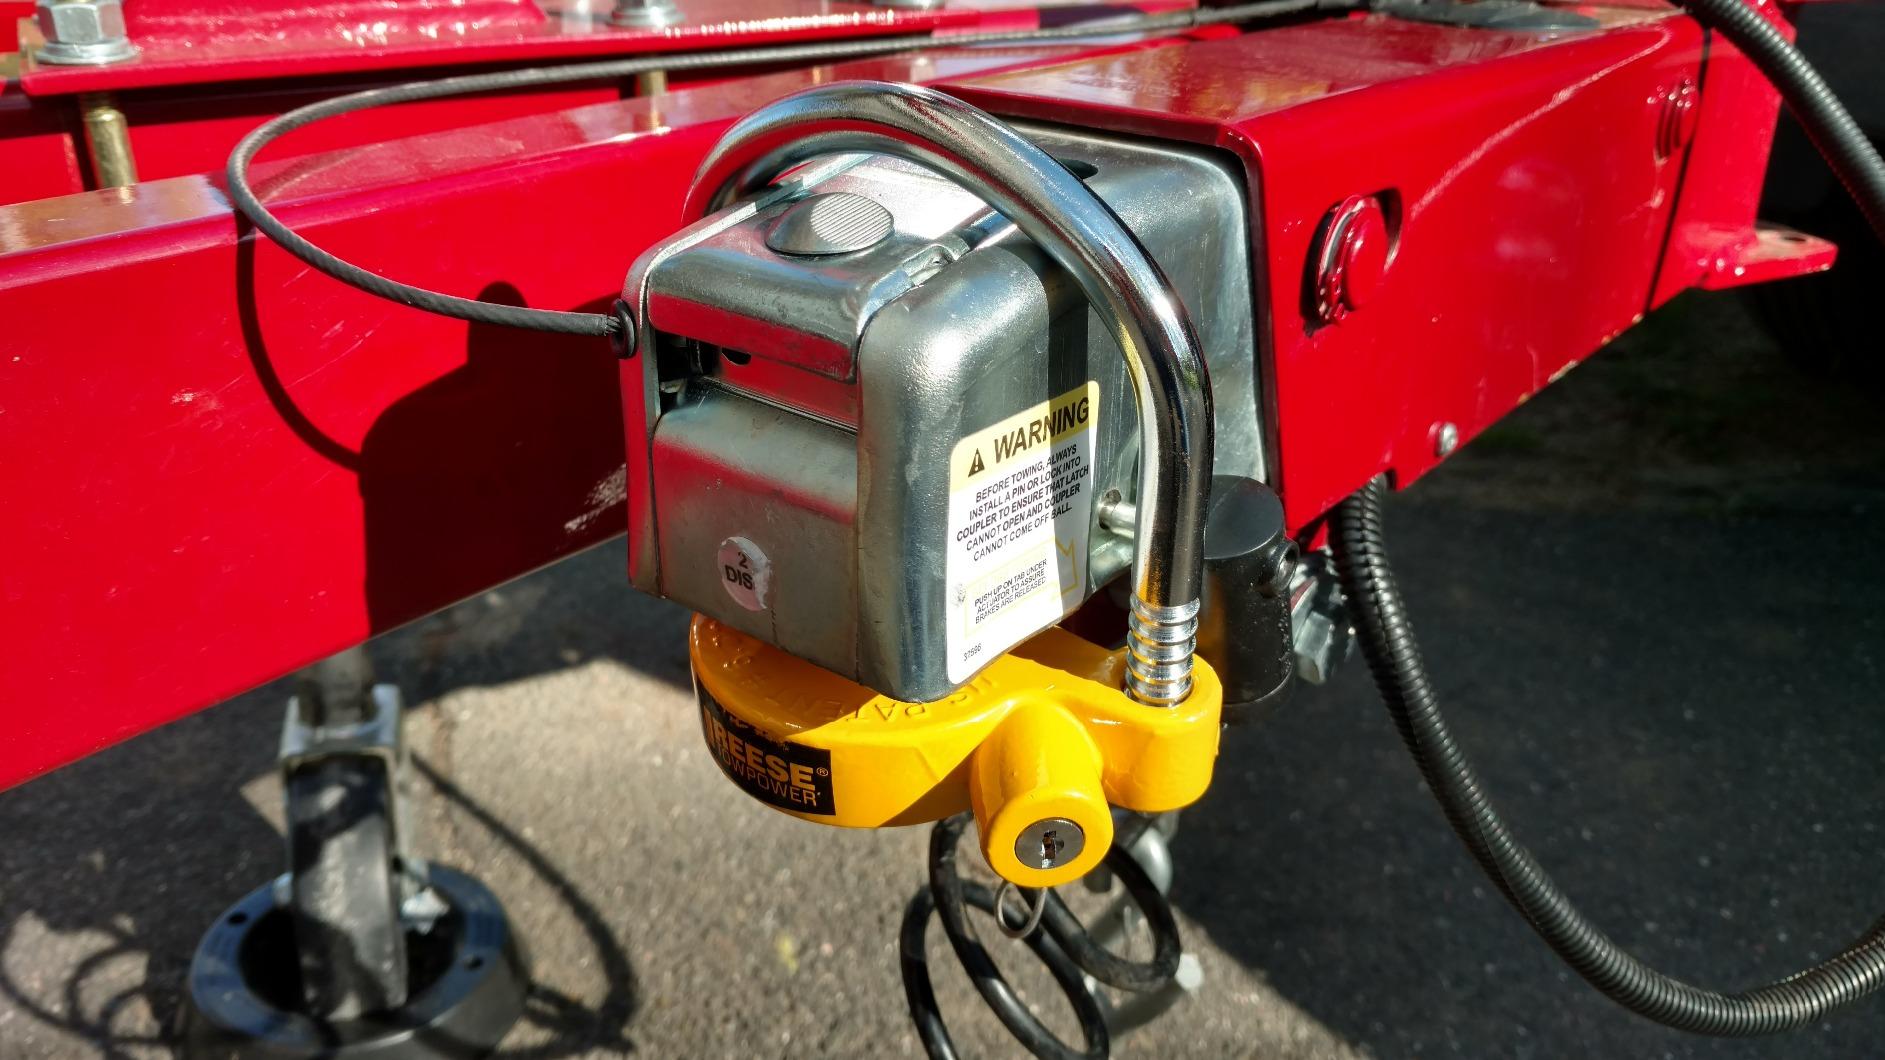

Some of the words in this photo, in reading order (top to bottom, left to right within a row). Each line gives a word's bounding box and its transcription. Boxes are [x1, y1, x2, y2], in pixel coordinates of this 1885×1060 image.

[994, 397, 1089, 464] WARNING
[969, 495, 1005, 521] INSTALL
[1004, 492, 1011, 504] A
[1012, 484, 1025, 499] PIN
[1027, 477, 1039, 491] OR
[1040, 467, 1062, 486] LOCK
[1063, 456, 1081, 473] INTO
[976, 477, 1010, 503] BEFORE
[1011, 461, 1044, 484] TOWING,
[1046, 444, 1077, 467] ALWAYS
[956, 513, 997, 542] COUPLER
[999, 506, 1010, 520] TO
[1011, 488, 1043, 513] ENSURE
[1045, 477, 1065, 496] THAT
[1066, 464, 1089, 486] LATCH
[966, 524, 1001, 551] CANNOT
[1002, 511, 1026, 531] OPEN
[1026, 502, 1043, 520] AND
[1044, 482, 1081, 509] COUPLER
[738, 551, 748, 569] 2
[973, 535, 1008, 561] CANNOT
[1009, 521, 1033, 541] COME
[1034, 513, 1050, 528] OFF
[725, 564, 753, 590] DIS
[974, 590, 993, 607] PUSH
[993, 583, 1003, 595] UP
[1003, 579, 1013, 590] ON
[1014, 571, 1025, 583] TAB
[1026, 558, 1047, 576] UNDER
[975, 602, 1000, 624] BRAKES
[1000, 594, 1014, 609] ARE
[1014, 576, 1046, 599] RELEASED
[976, 588, 1010, 615] ACTUATOR
[1010, 583, 1020, 593] TO
[1020, 568, 1045, 587] ASSURE
